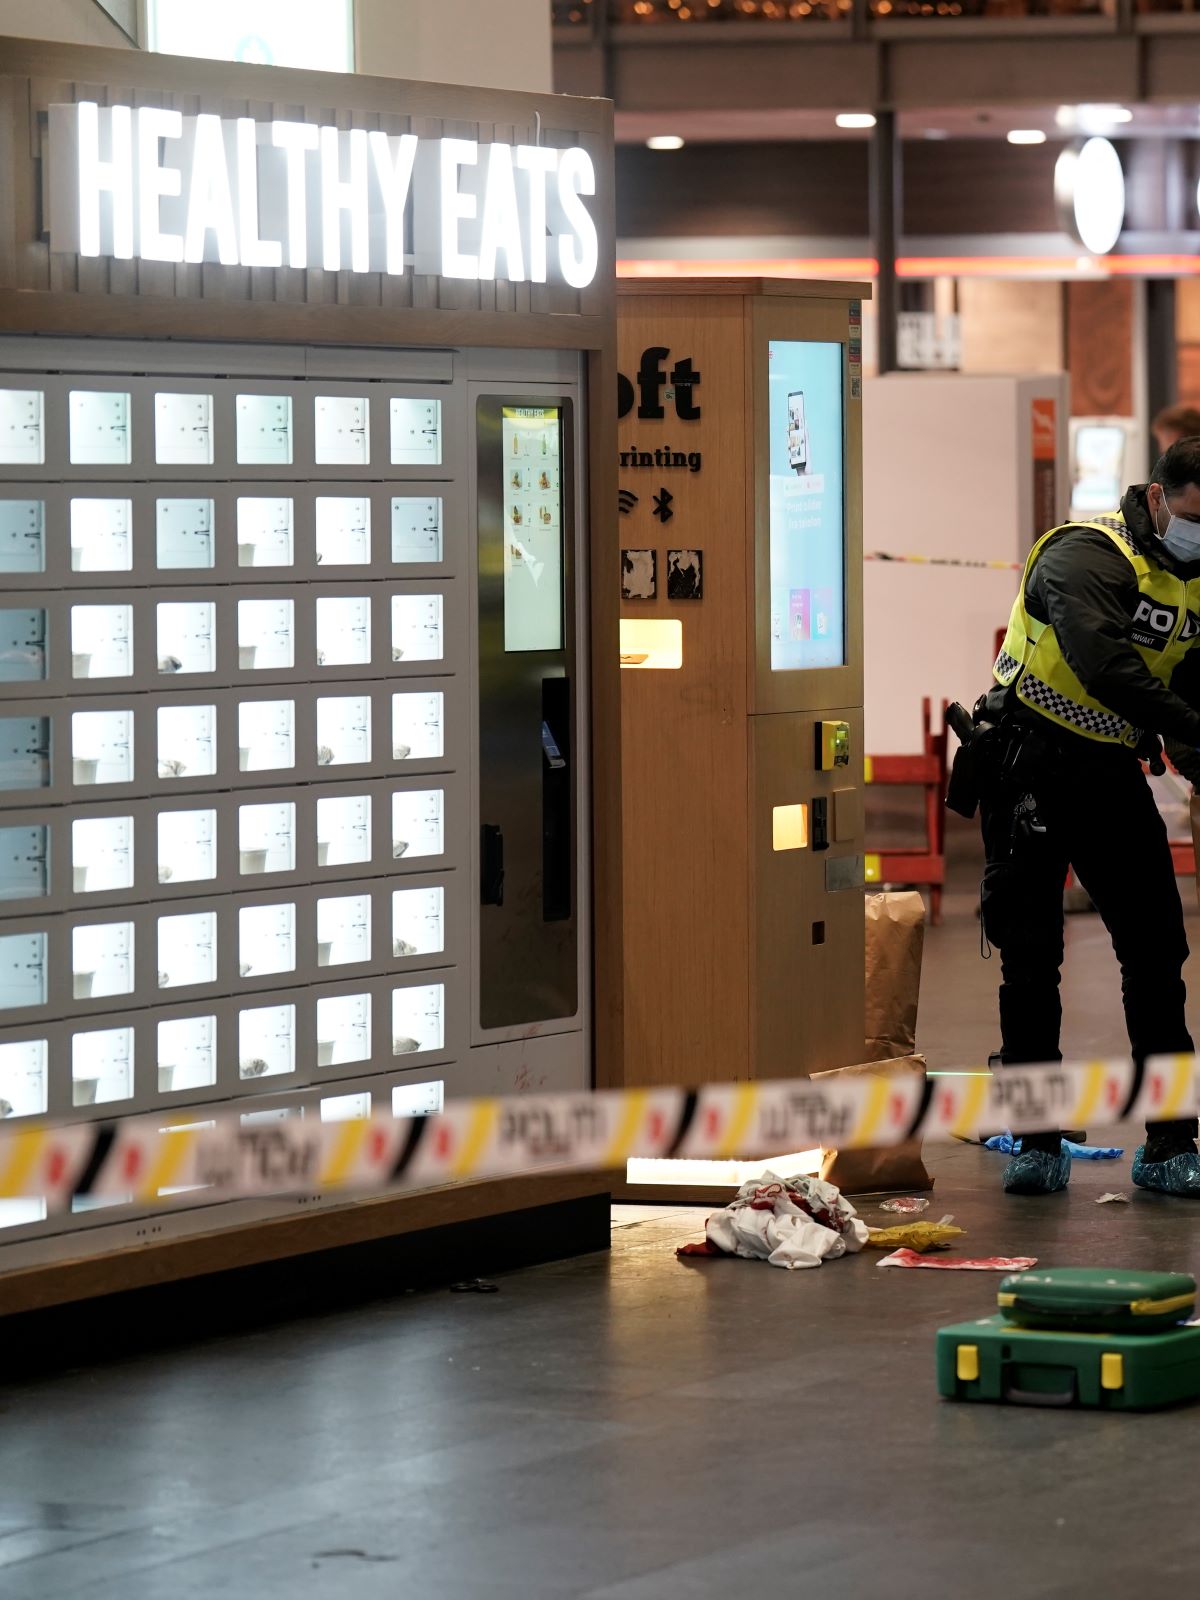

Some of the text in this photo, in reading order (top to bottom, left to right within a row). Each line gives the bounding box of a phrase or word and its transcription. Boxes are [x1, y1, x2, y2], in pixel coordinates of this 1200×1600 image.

[78, 101, 598, 287] HEALTHY EATS
[619, 445, 702, 473] rinting
